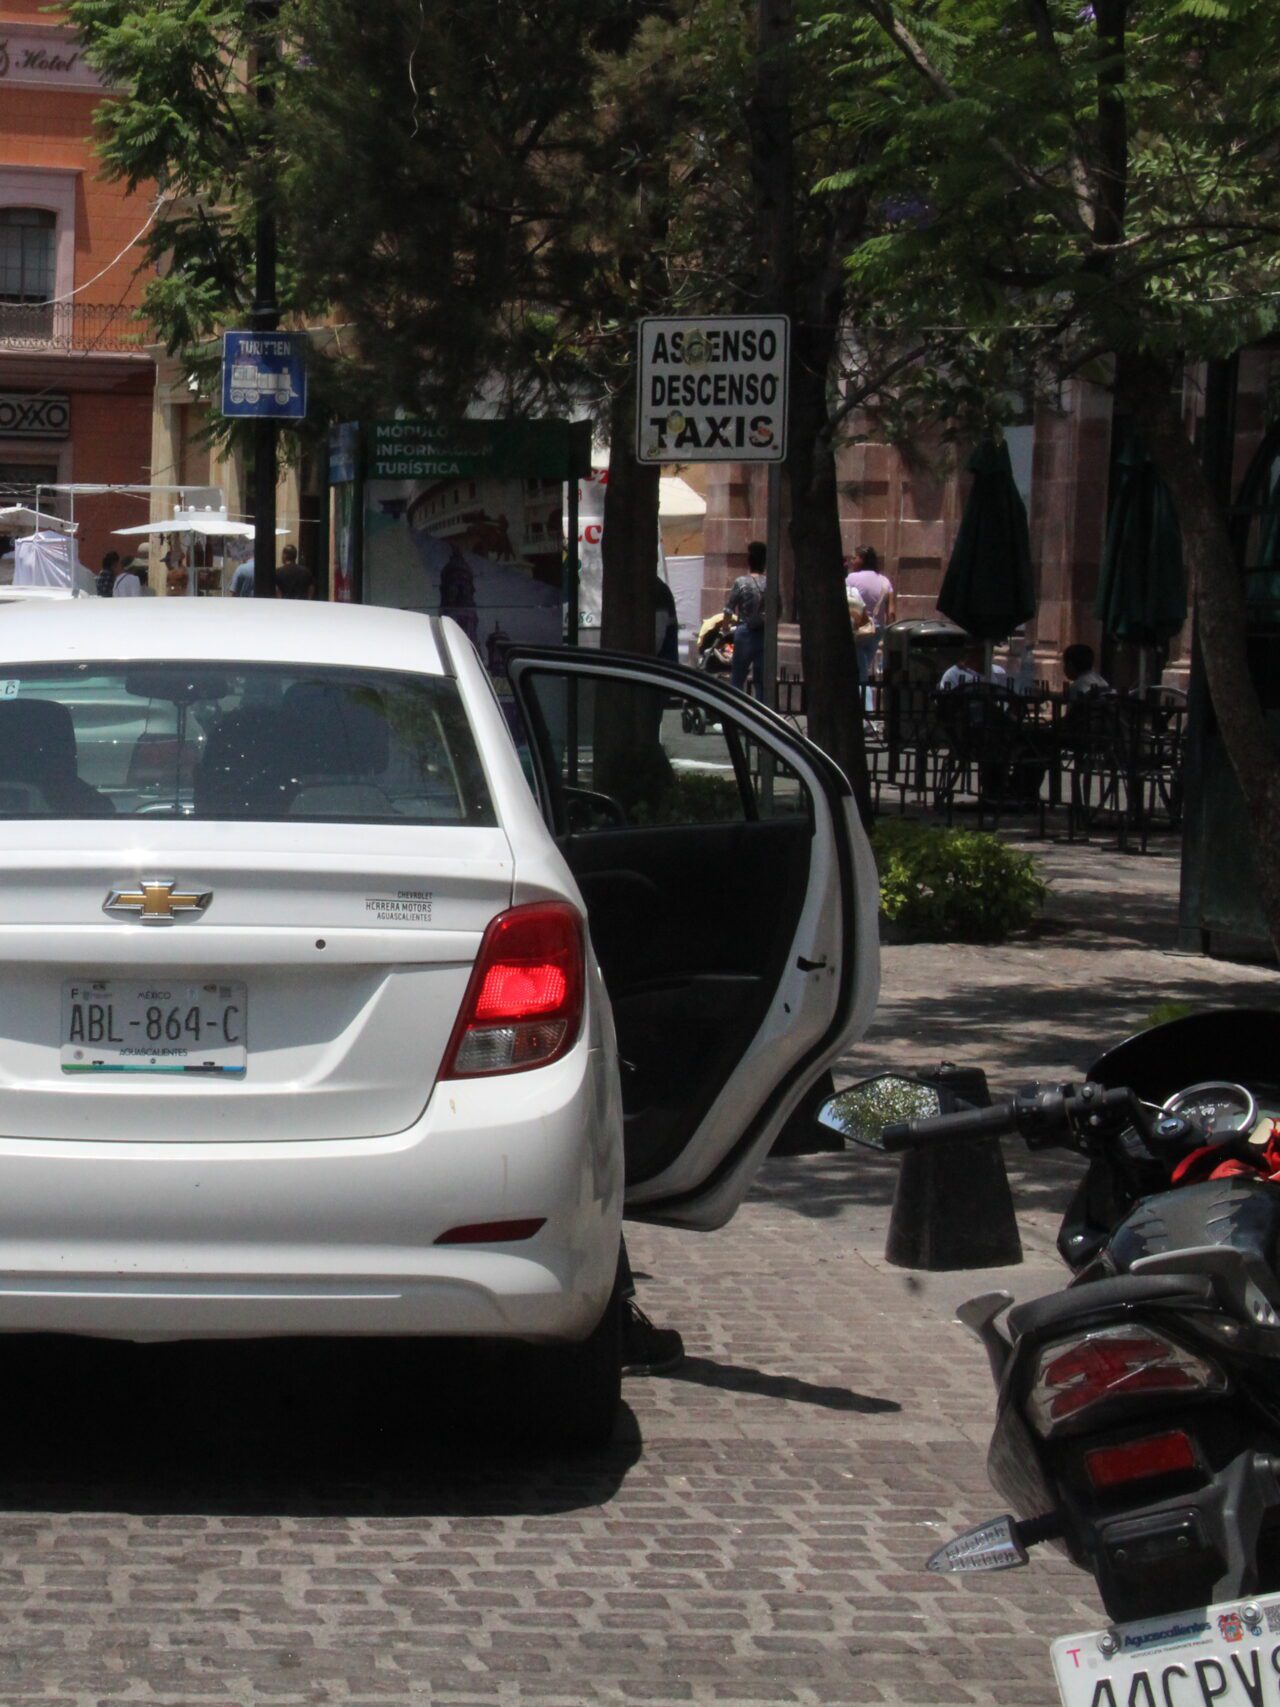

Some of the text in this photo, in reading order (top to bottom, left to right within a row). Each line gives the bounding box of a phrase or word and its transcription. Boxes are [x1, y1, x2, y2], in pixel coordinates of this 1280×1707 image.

[15, 49, 79, 72] Hotel
[651, 329, 777, 364] ASENSO
[651, 373, 777, 407] DESCENSO
[650, 416, 775, 448] TAXIS
[376, 459, 460, 474] TURÍSTICA
[397, 891, 433, 900] CHEVROLET
[377, 912, 432, 922] AGUASCALIENTES
[402, 903, 432, 912] MOTORS
[71, 988, 79, 999] F
[70, 1004, 239, 1042] ABL-864-C
[1124, 1621, 1212, 1647] Aguascalientes
[1066, 1648, 1081, 1668] T
